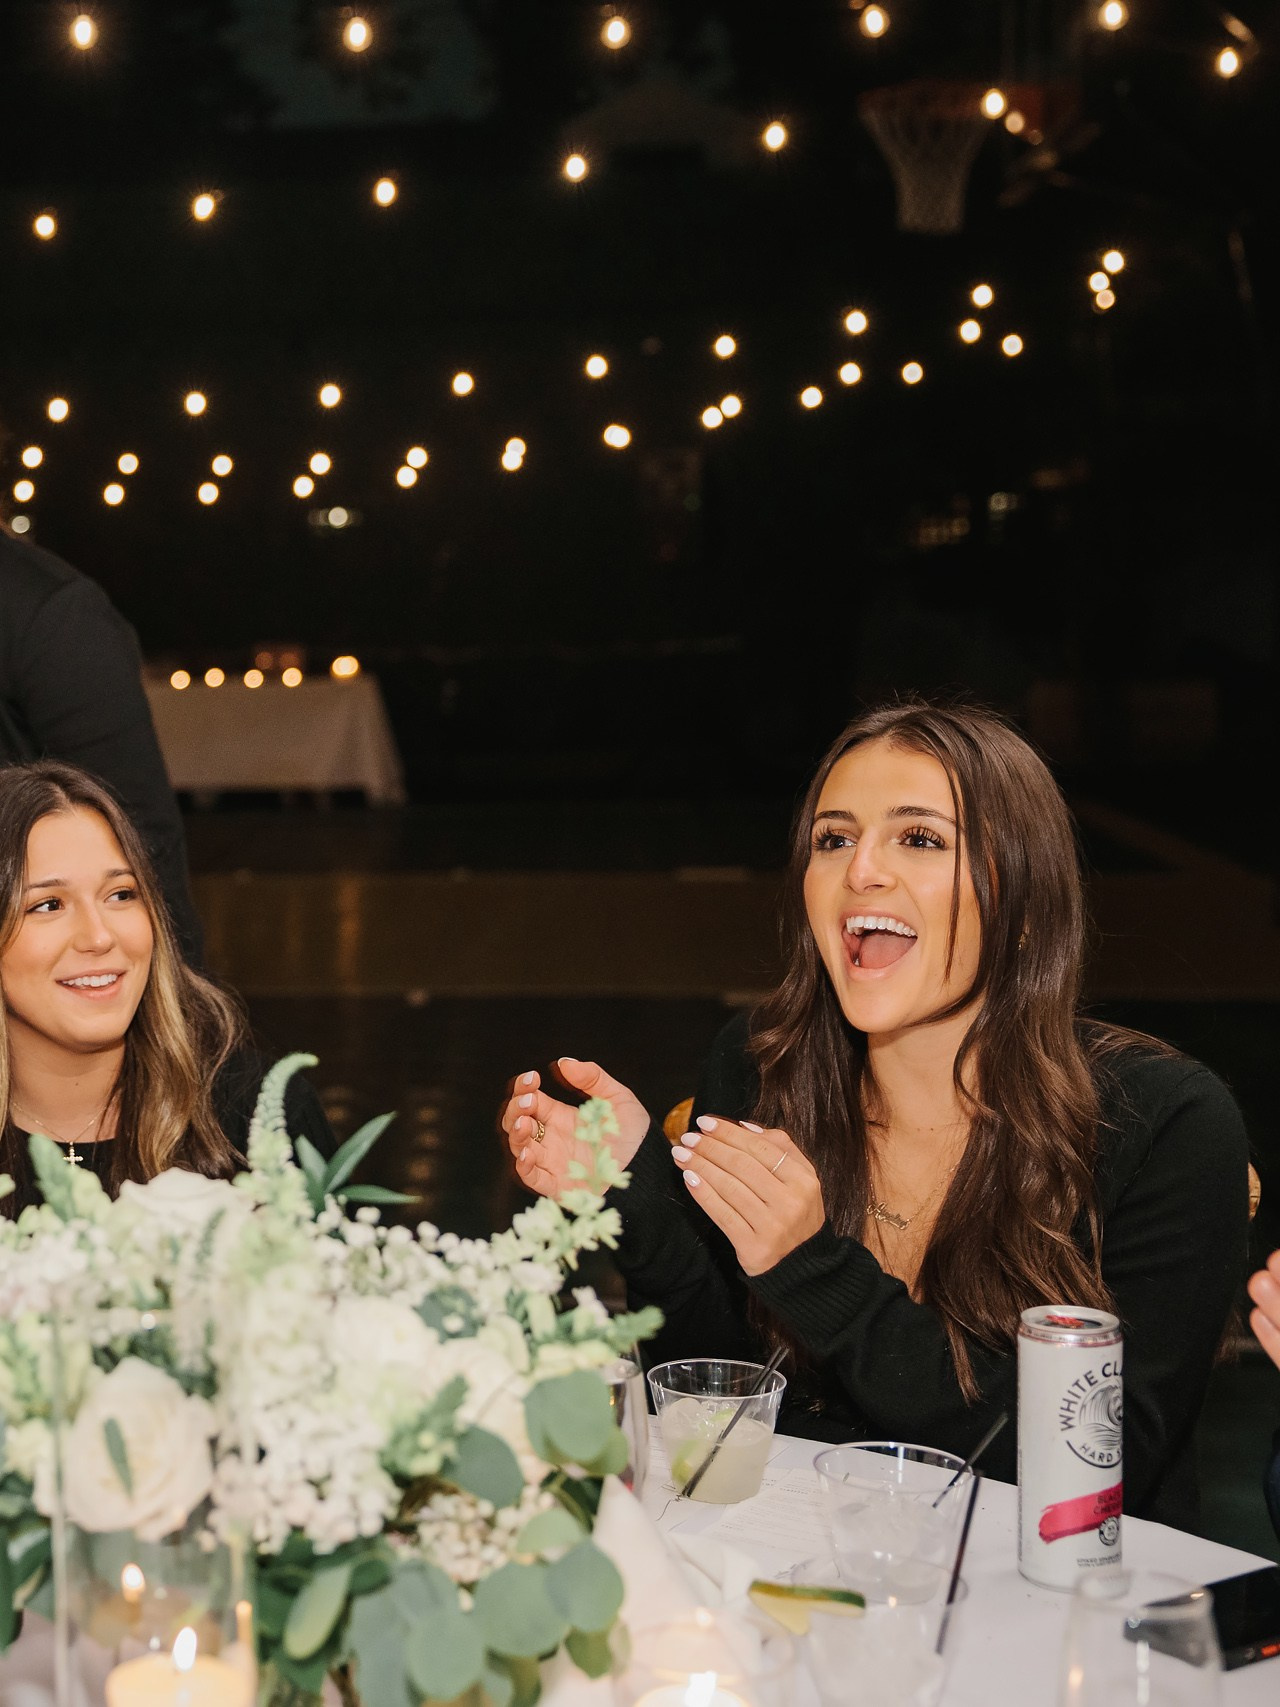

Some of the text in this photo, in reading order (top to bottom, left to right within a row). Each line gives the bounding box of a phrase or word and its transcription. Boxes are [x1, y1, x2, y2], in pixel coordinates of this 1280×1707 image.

[1059, 1360, 1123, 1432] WHITE CL
[1079, 1443, 1113, 1463] HARD
